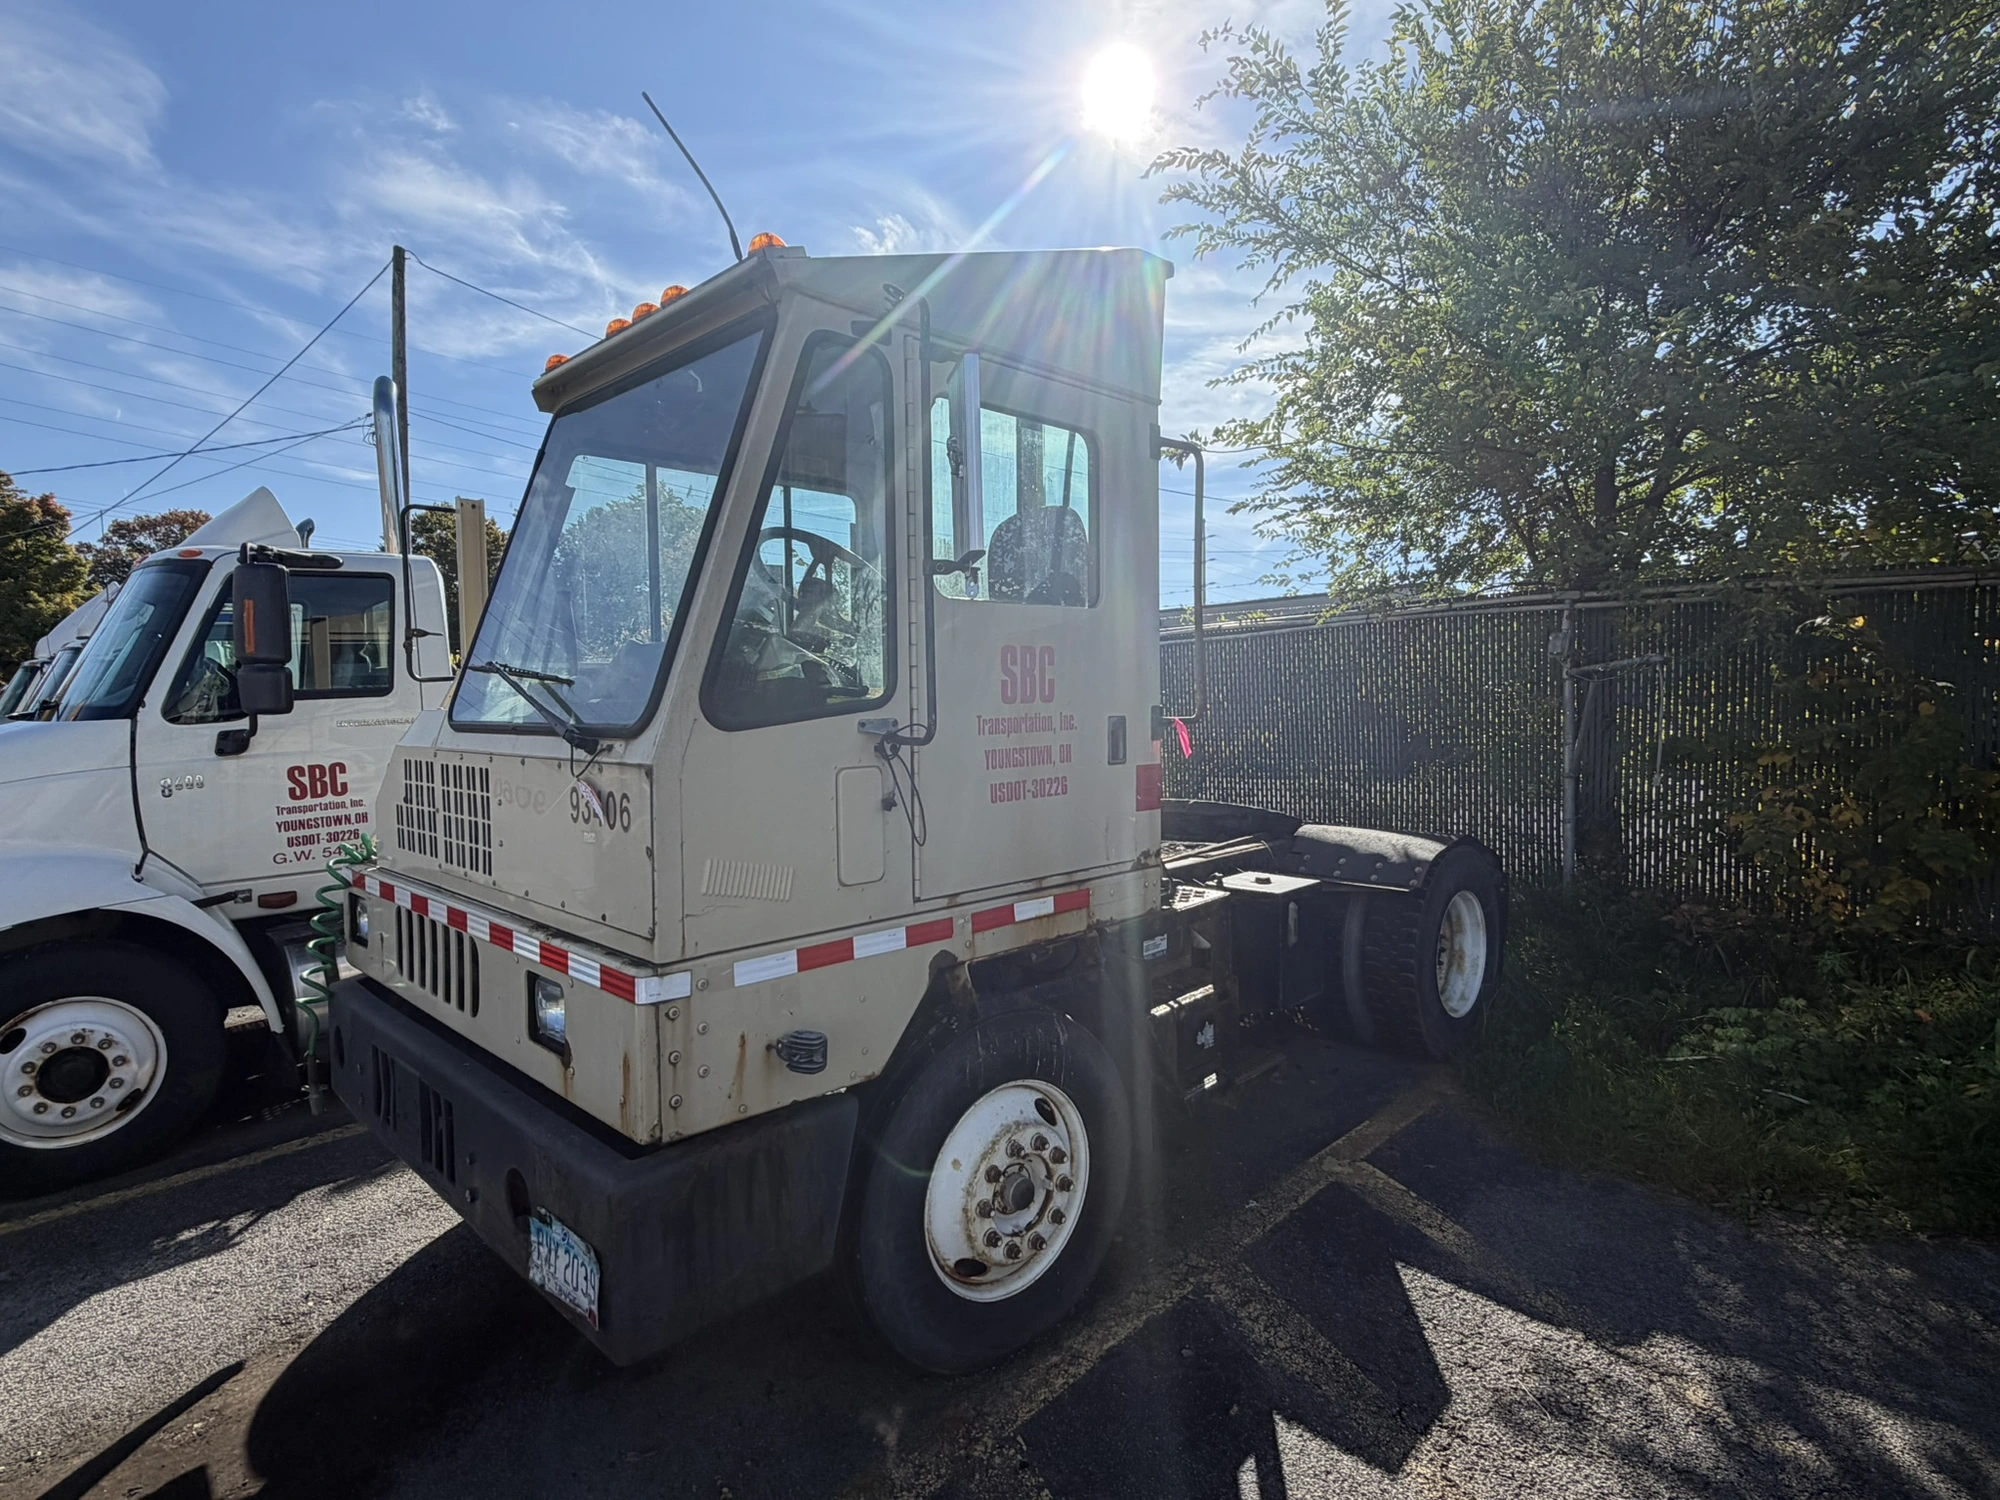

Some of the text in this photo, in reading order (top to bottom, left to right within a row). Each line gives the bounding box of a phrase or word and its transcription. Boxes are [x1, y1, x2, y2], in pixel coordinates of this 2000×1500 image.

[1001, 644, 1055, 705] SBC
[976, 711, 1078, 738] Transportation, Inc.
[984, 743, 1072, 771] YOUNGSTOWN, OH
[286, 762, 348, 801] SBC
[989, 775, 1068, 804] USDOT-30226
[275, 798, 366, 816] Transportation, Inc.
[286, 828, 360, 848] USDOT-30226
[273, 849, 315, 865] G.W.
